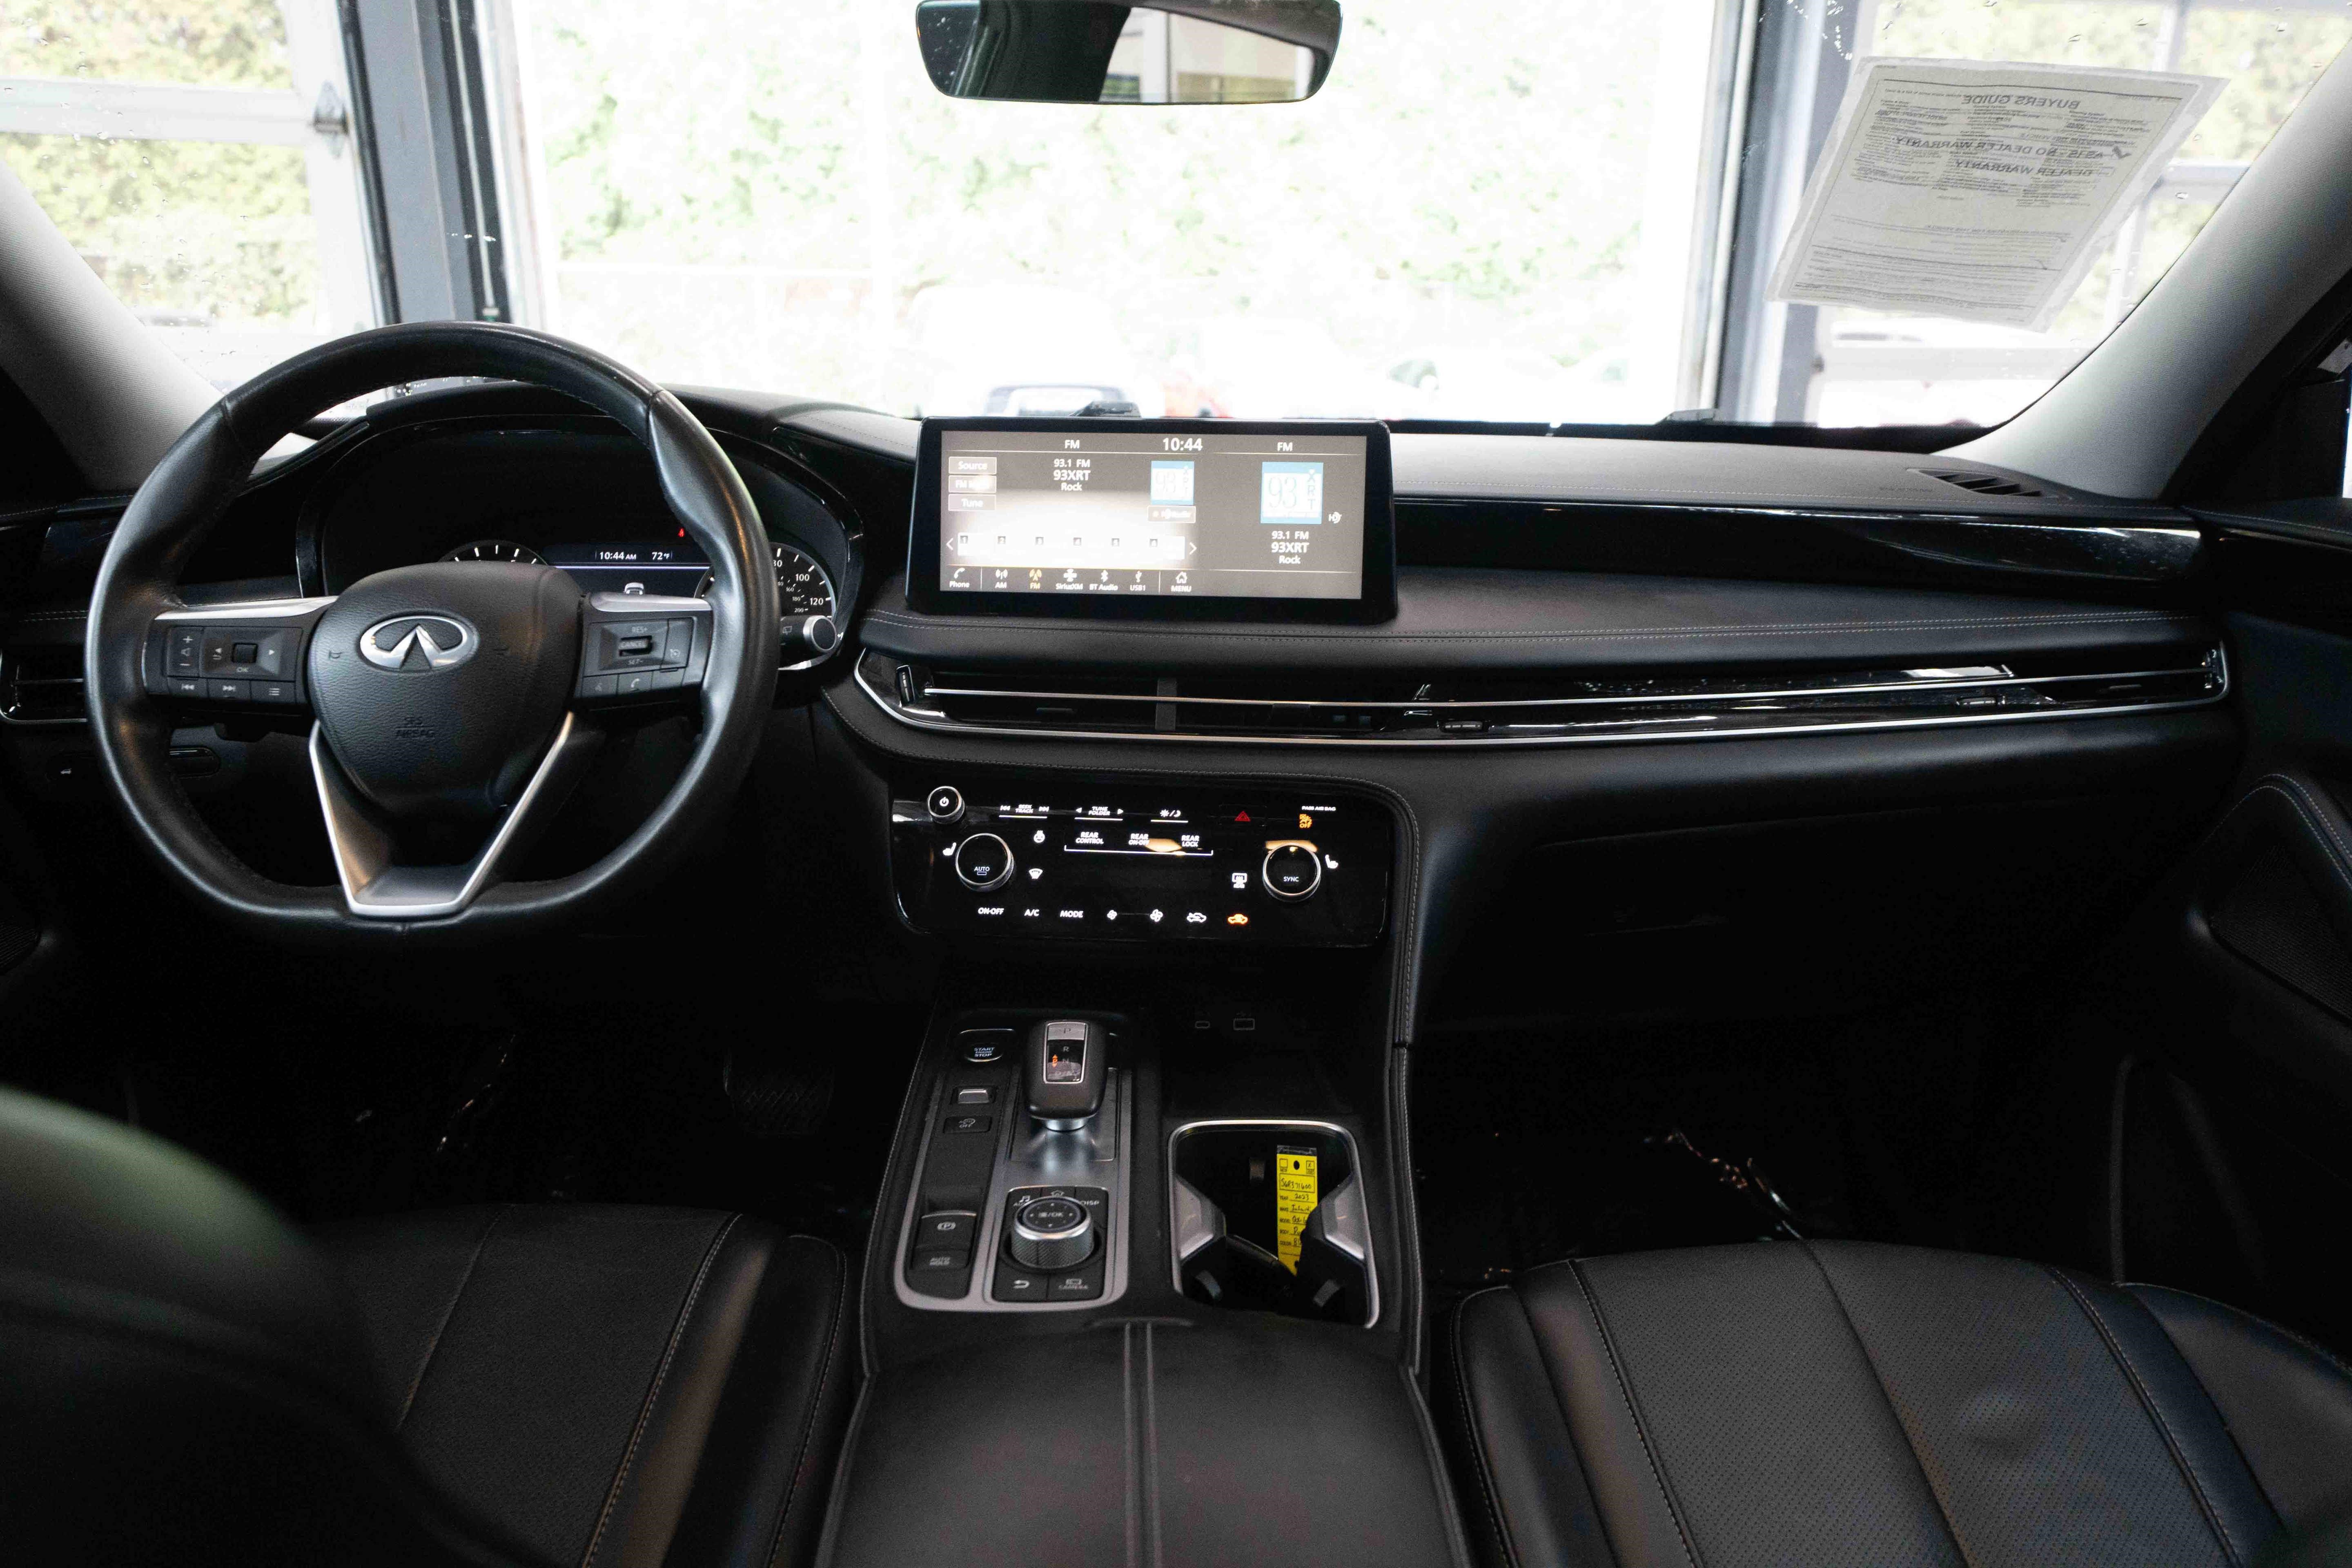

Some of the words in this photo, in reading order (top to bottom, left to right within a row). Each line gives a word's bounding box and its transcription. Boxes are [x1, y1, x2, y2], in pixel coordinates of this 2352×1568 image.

[1065, 439, 1080, 449] FM
[1163, 437, 1203, 451] 10:44
[1277, 442, 1293, 451] FM
[1054, 459, 1071, 468] 93.1
[1076, 459, 1090, 468] FM
[1053, 470, 1091, 481] 93XRT
[1061, 482, 1082, 491] Rock
[1271, 530, 1290, 539] 93.1
[1294, 531, 1309, 539] FM
[1271, 541, 1310, 553] 93XRT
[600, 552, 625, 560] 10:44
[1278, 555, 1301, 564] Rock
